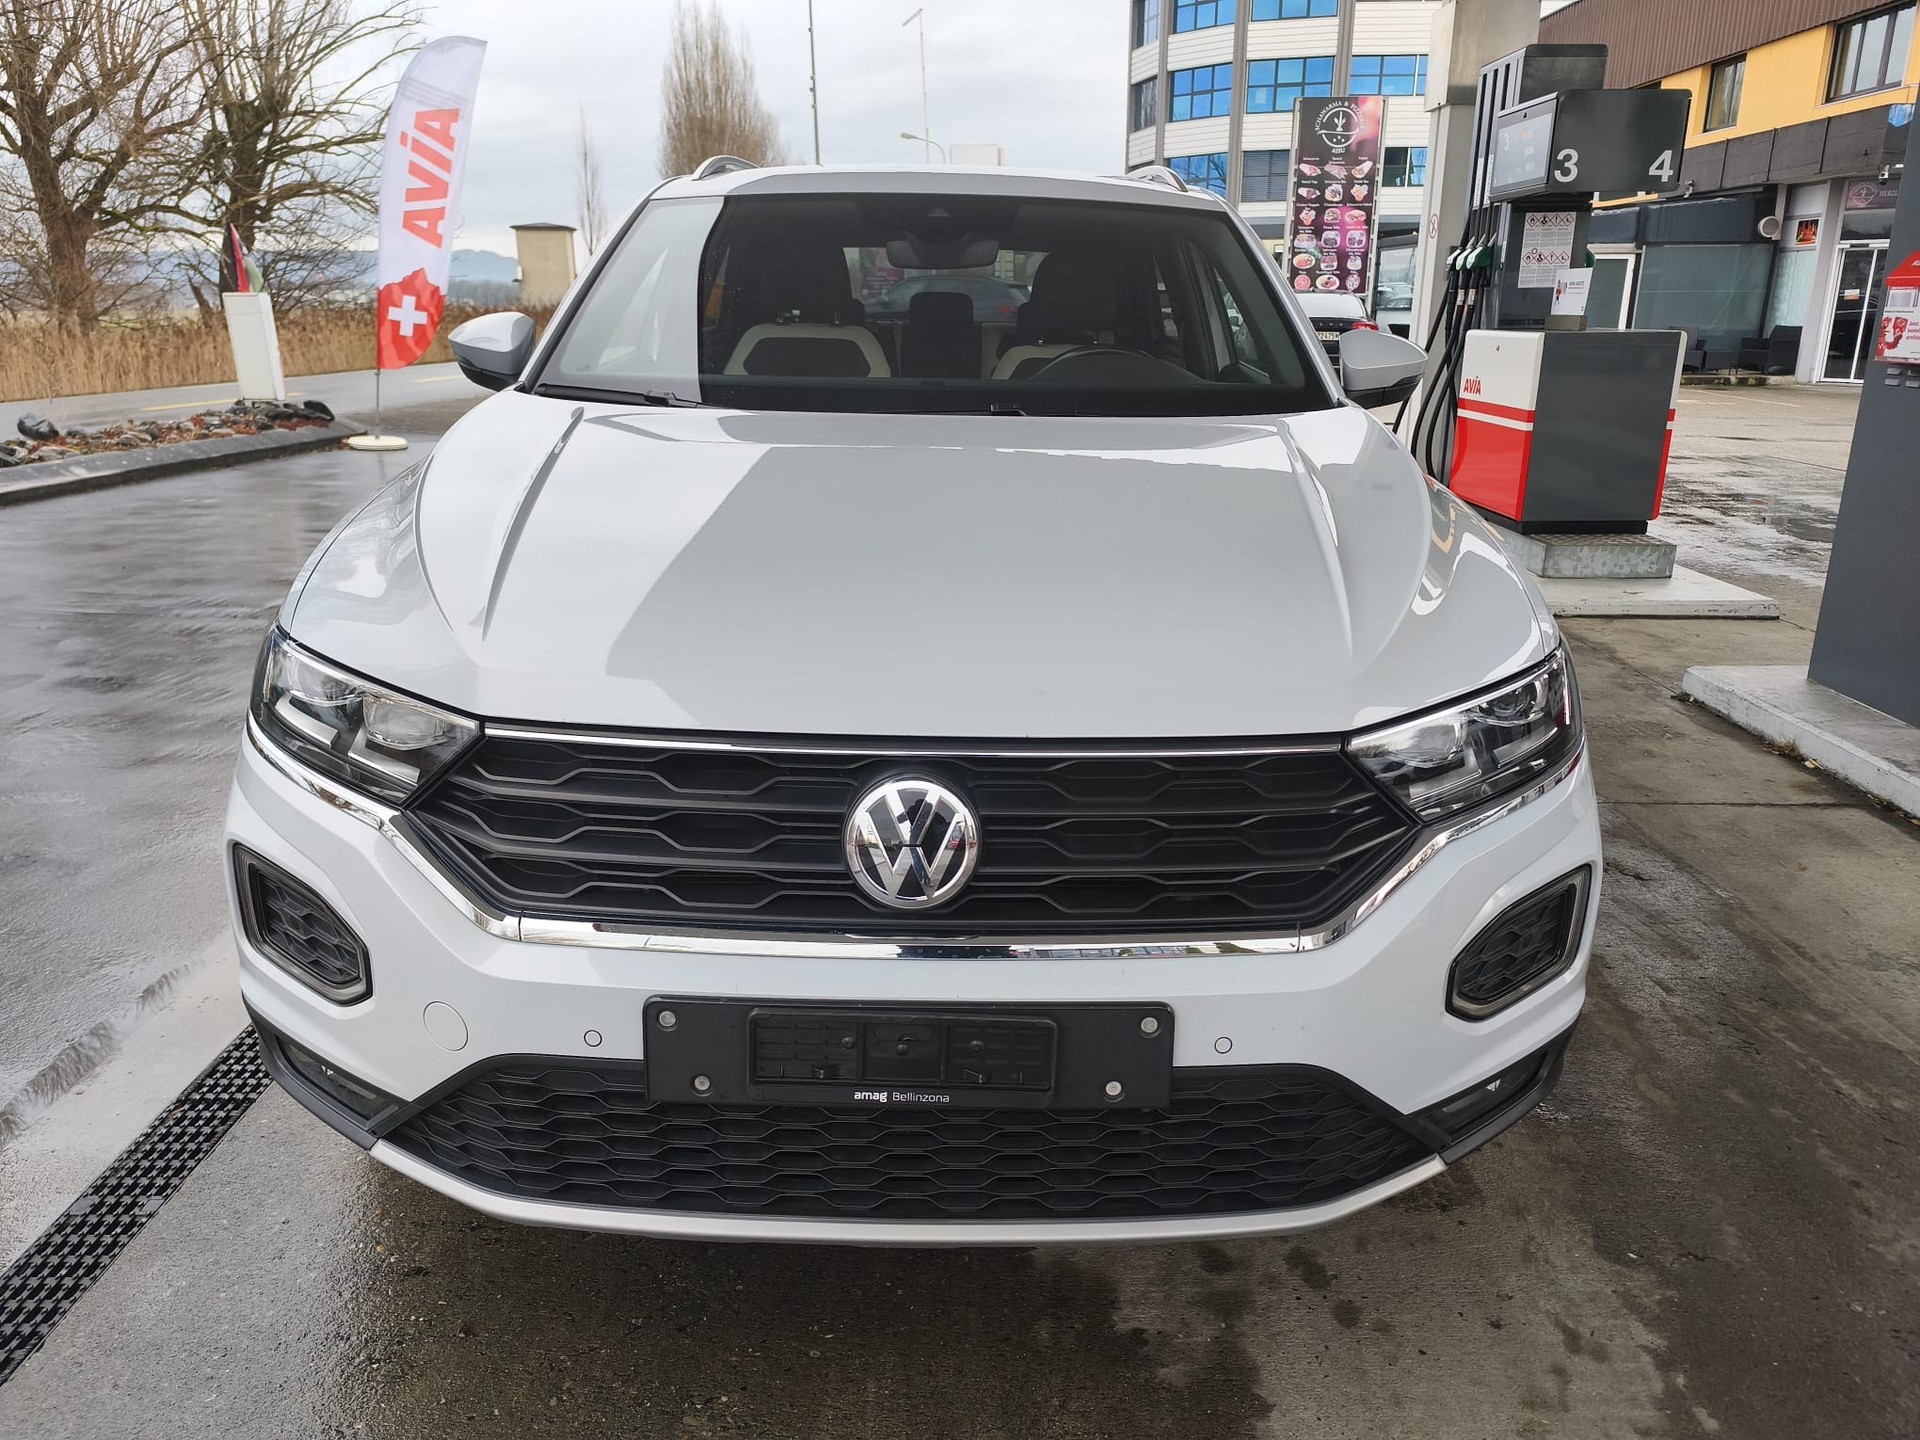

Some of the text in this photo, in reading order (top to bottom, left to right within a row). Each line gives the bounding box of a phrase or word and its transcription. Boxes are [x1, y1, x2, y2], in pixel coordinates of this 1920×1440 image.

[1554, 148, 1579, 183] 3
[1648, 149, 1674, 183] 4
[854, 1091, 950, 1103] amag Bellinzona
